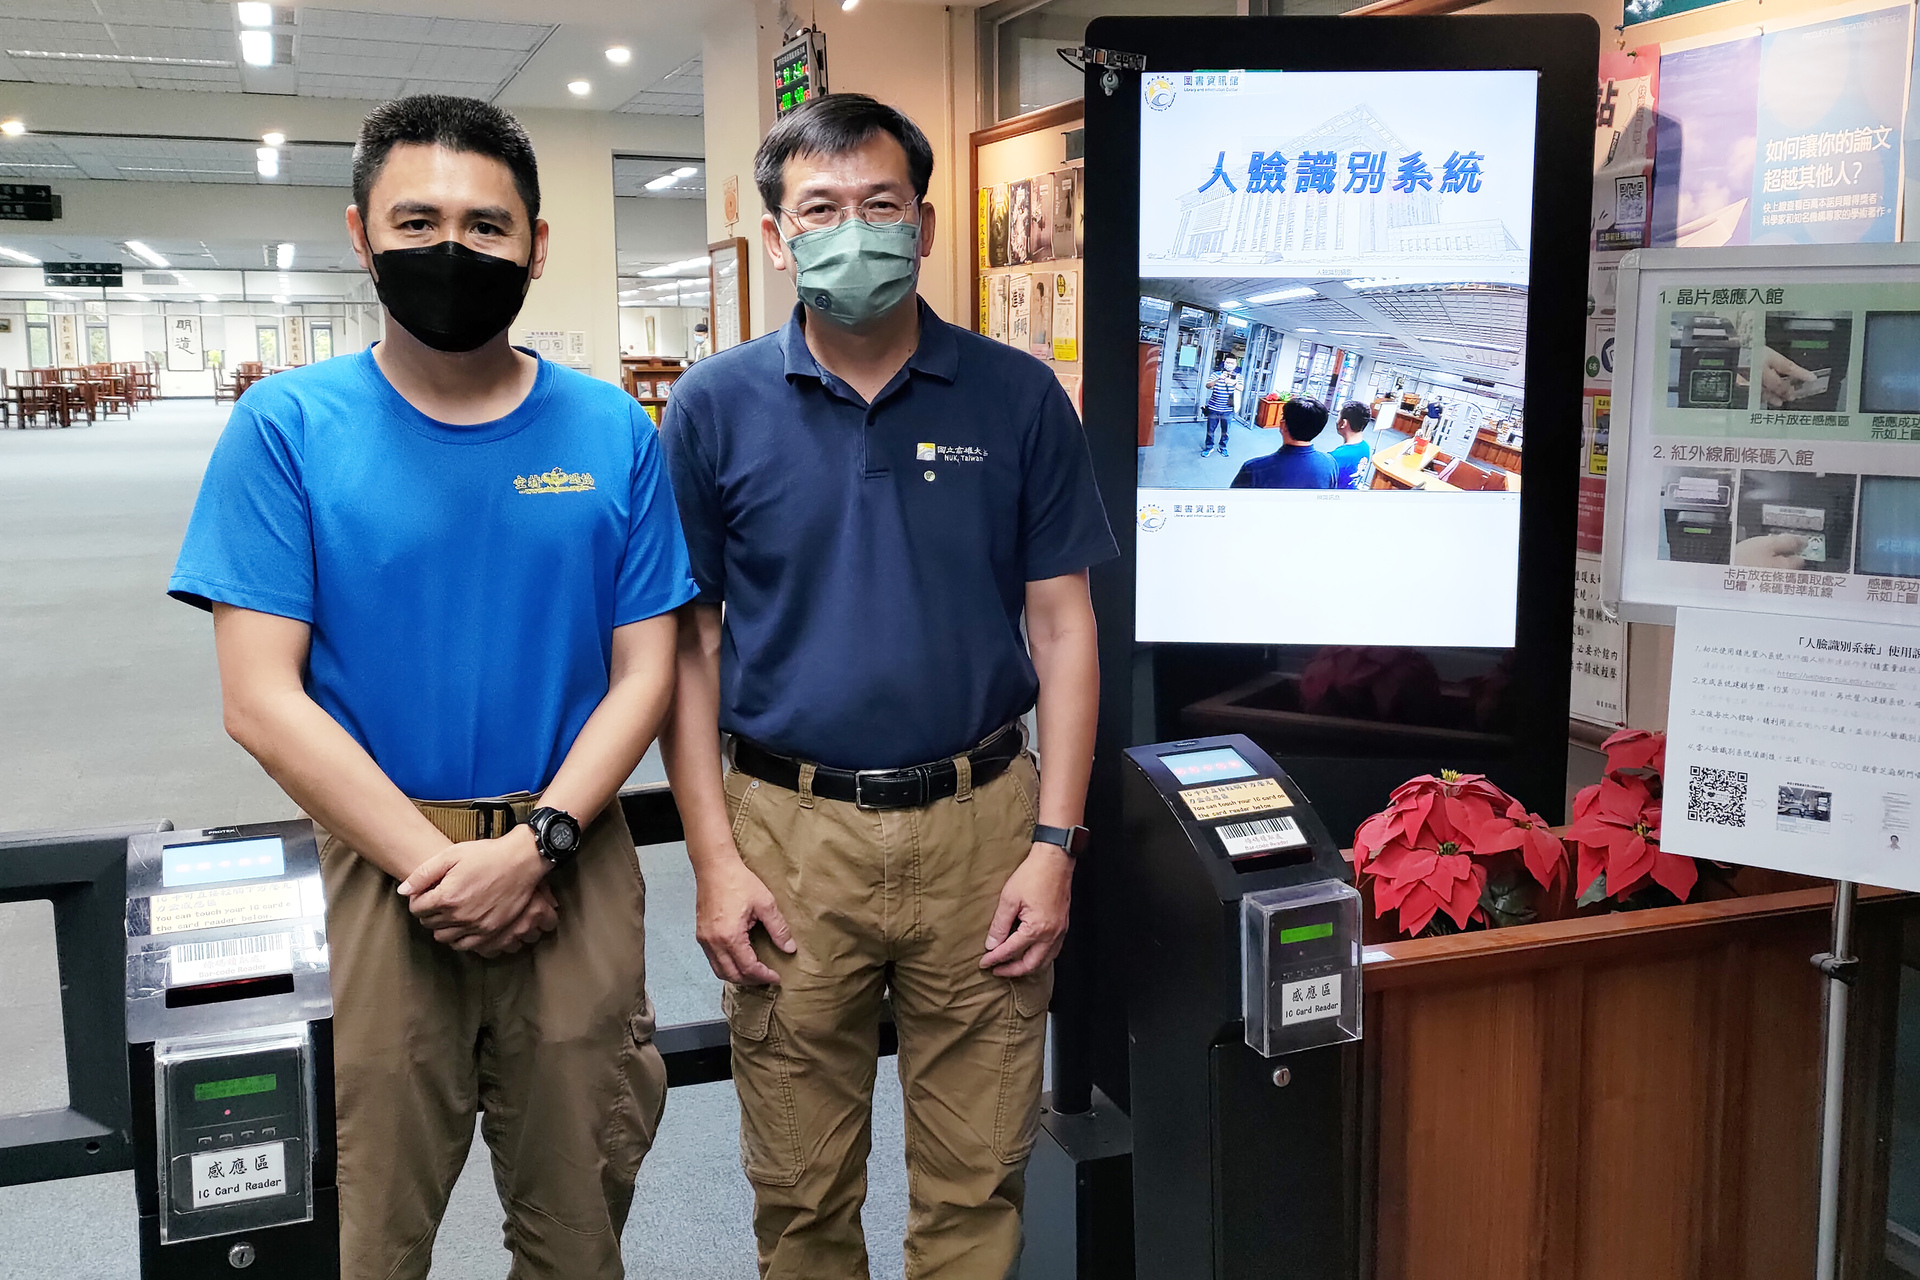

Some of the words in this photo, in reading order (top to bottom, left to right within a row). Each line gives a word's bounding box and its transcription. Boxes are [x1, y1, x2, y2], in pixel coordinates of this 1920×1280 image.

[1765, 125, 1892, 163] 如何讓你的論文
[1198, 150, 1485, 194] 人臉識別系統
[1677, 288, 1784, 305] 晶片感應入館
[1750, 413, 1850, 427] 把卡片放在感應區
[960, 454, 984, 462] Taiwan
[1671, 444, 1814, 466] 紅外線刷條碼入館
[1867, 578, 1920, 592] 感應成功
[1219, 801, 1238, 809] touch
[156, 914, 172, 922] You
[195, 908, 222, 918] touch
[224, 907, 246, 915] your
[262, 902, 283, 910] card
[178, 921, 199, 930] card
[204, 918, 236, 927] reader
[241, 914, 272, 922] below.
[198, 967, 236, 978] Bar-code
[237, 964, 267, 973] Reader
[1292, 983, 1331, 1002] 感應區
[1296, 1006, 1312, 1016] Card
[1315, 1002, 1339, 1012] Reader
[207, 1154, 269, 1179] 感應區
[198, 1189, 210, 1199] IC
[215, 1183, 240, 1196] Card
[245, 1178, 282, 1191] Reader
